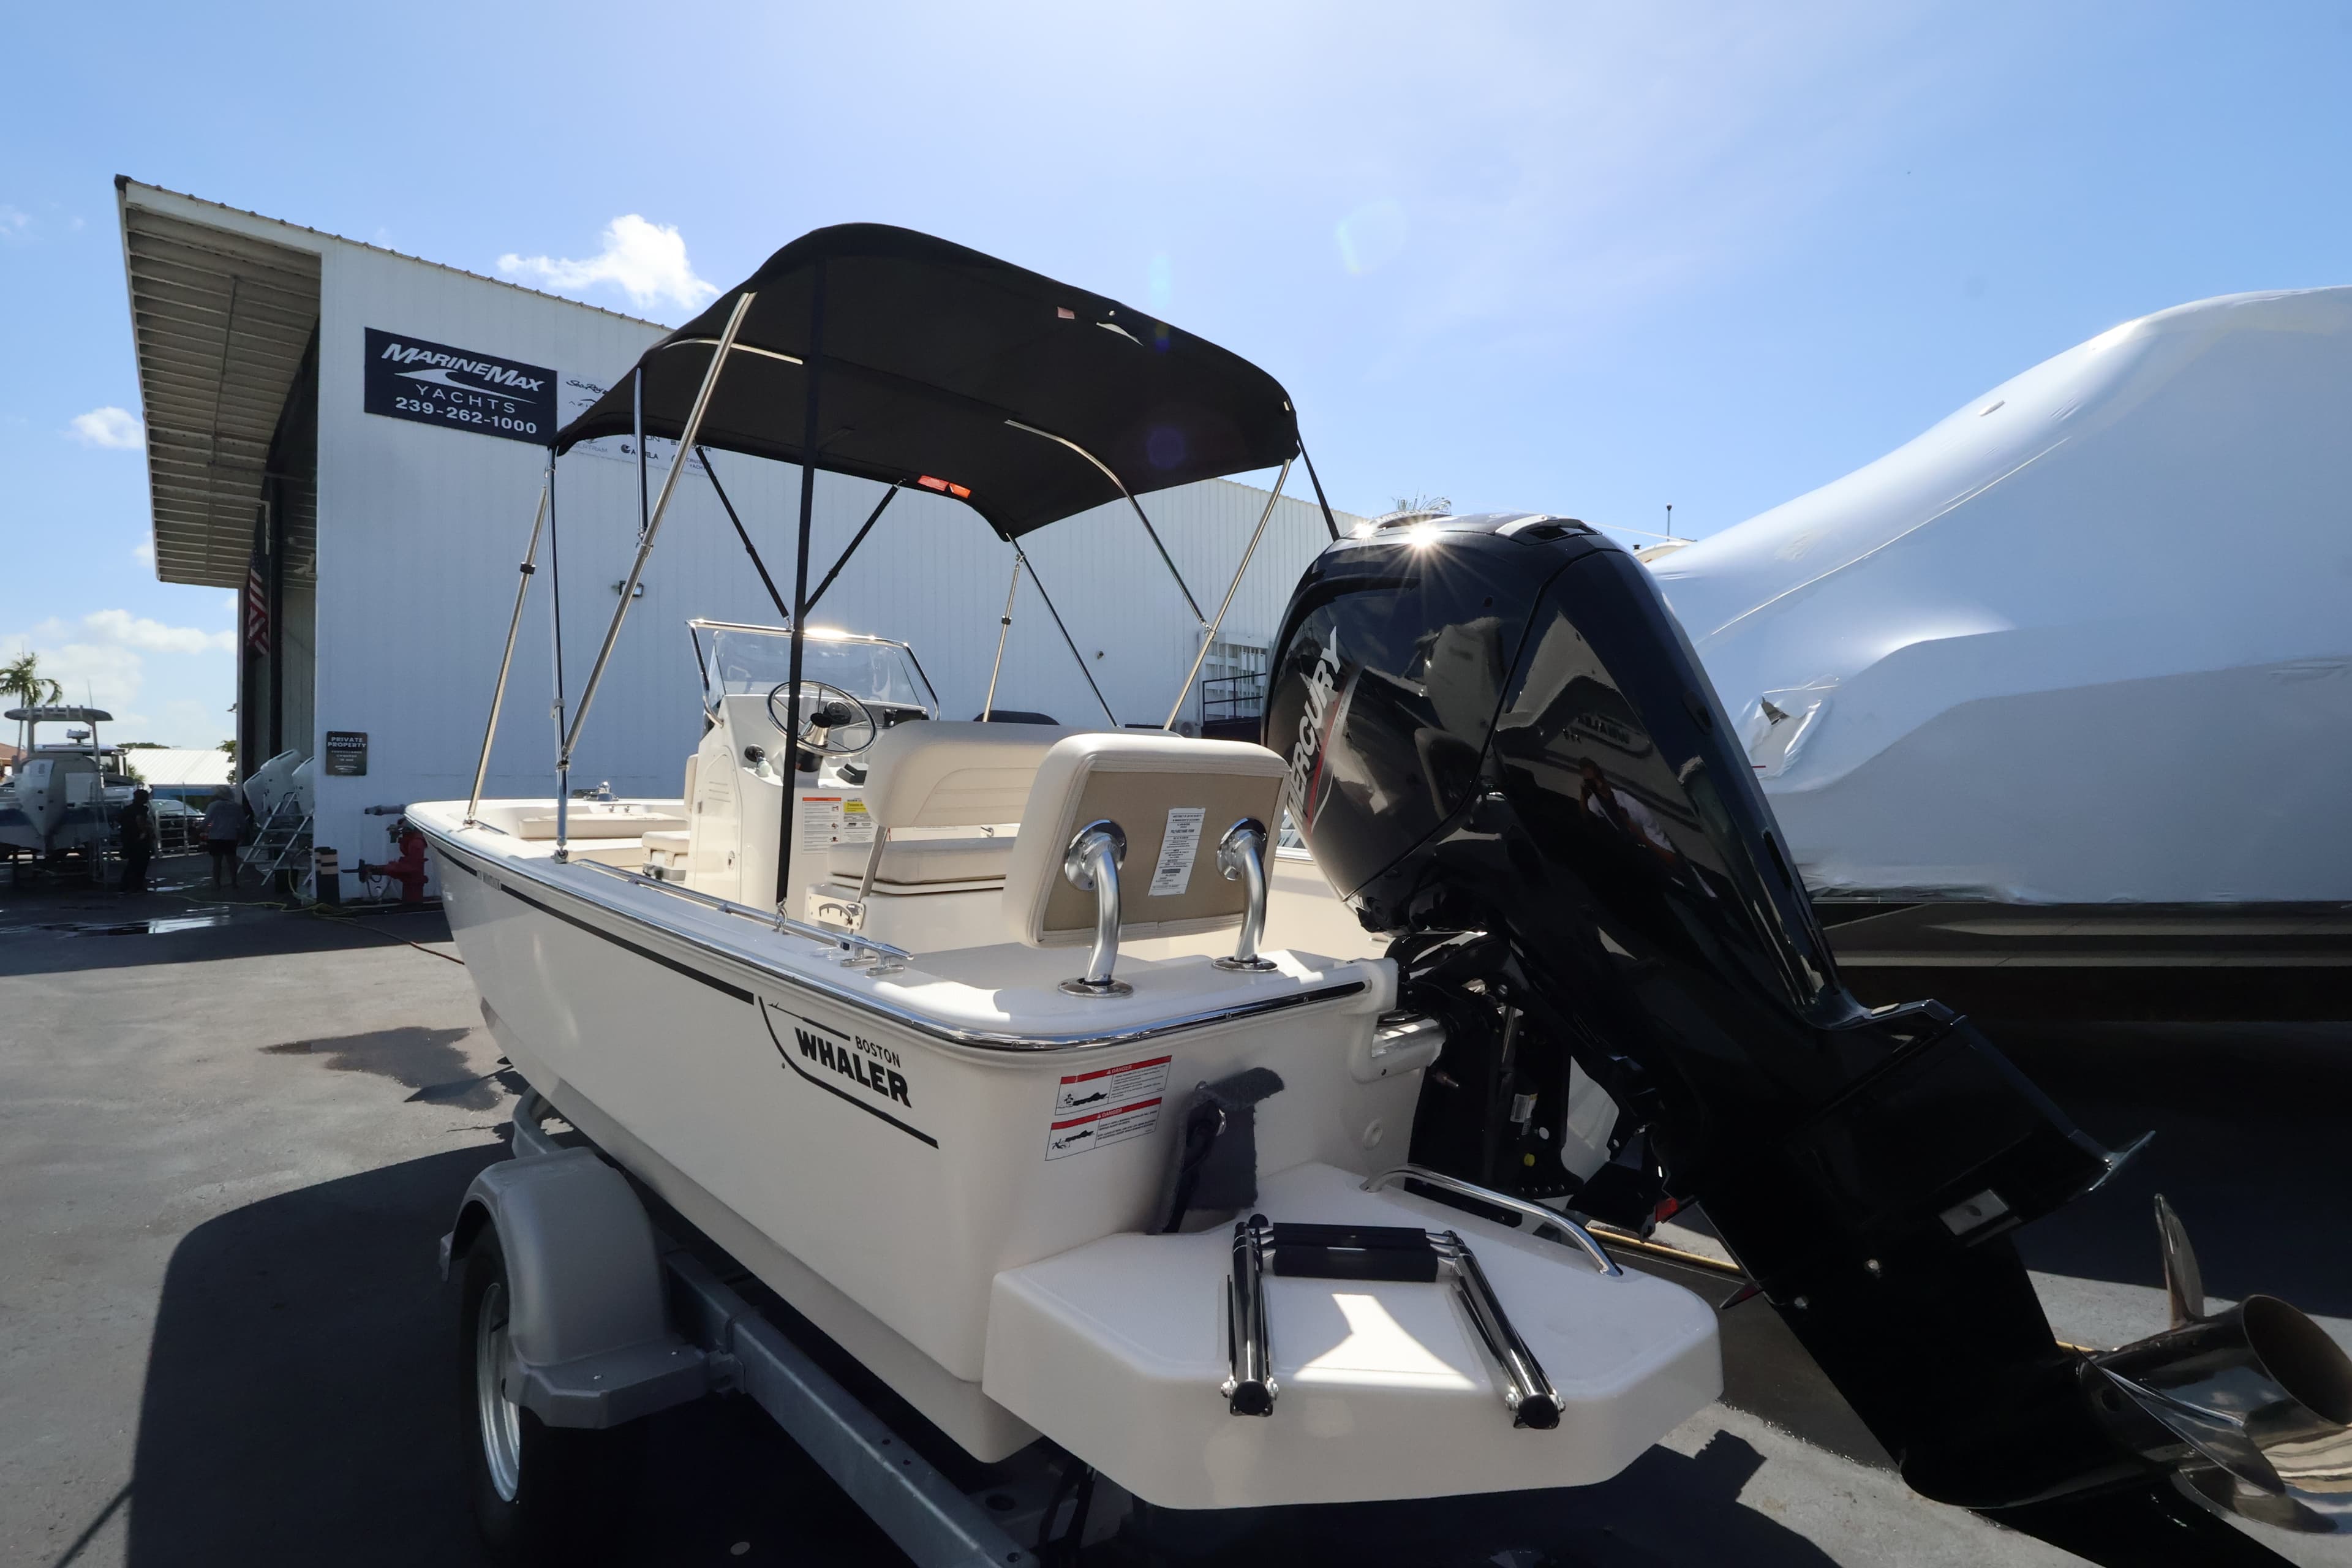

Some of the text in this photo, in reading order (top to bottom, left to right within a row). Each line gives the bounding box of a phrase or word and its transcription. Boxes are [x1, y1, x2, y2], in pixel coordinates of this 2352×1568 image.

[396, 397, 537, 434] 239-262-1000
[416, 383, 515, 413] YACHTS
[1288, 626, 1341, 824] MERCURY
[794, 1027, 912, 1109] WHALER
[855, 1035, 901, 1068] BOSTON
[1112, 1065, 1132, 1073] DANGER
